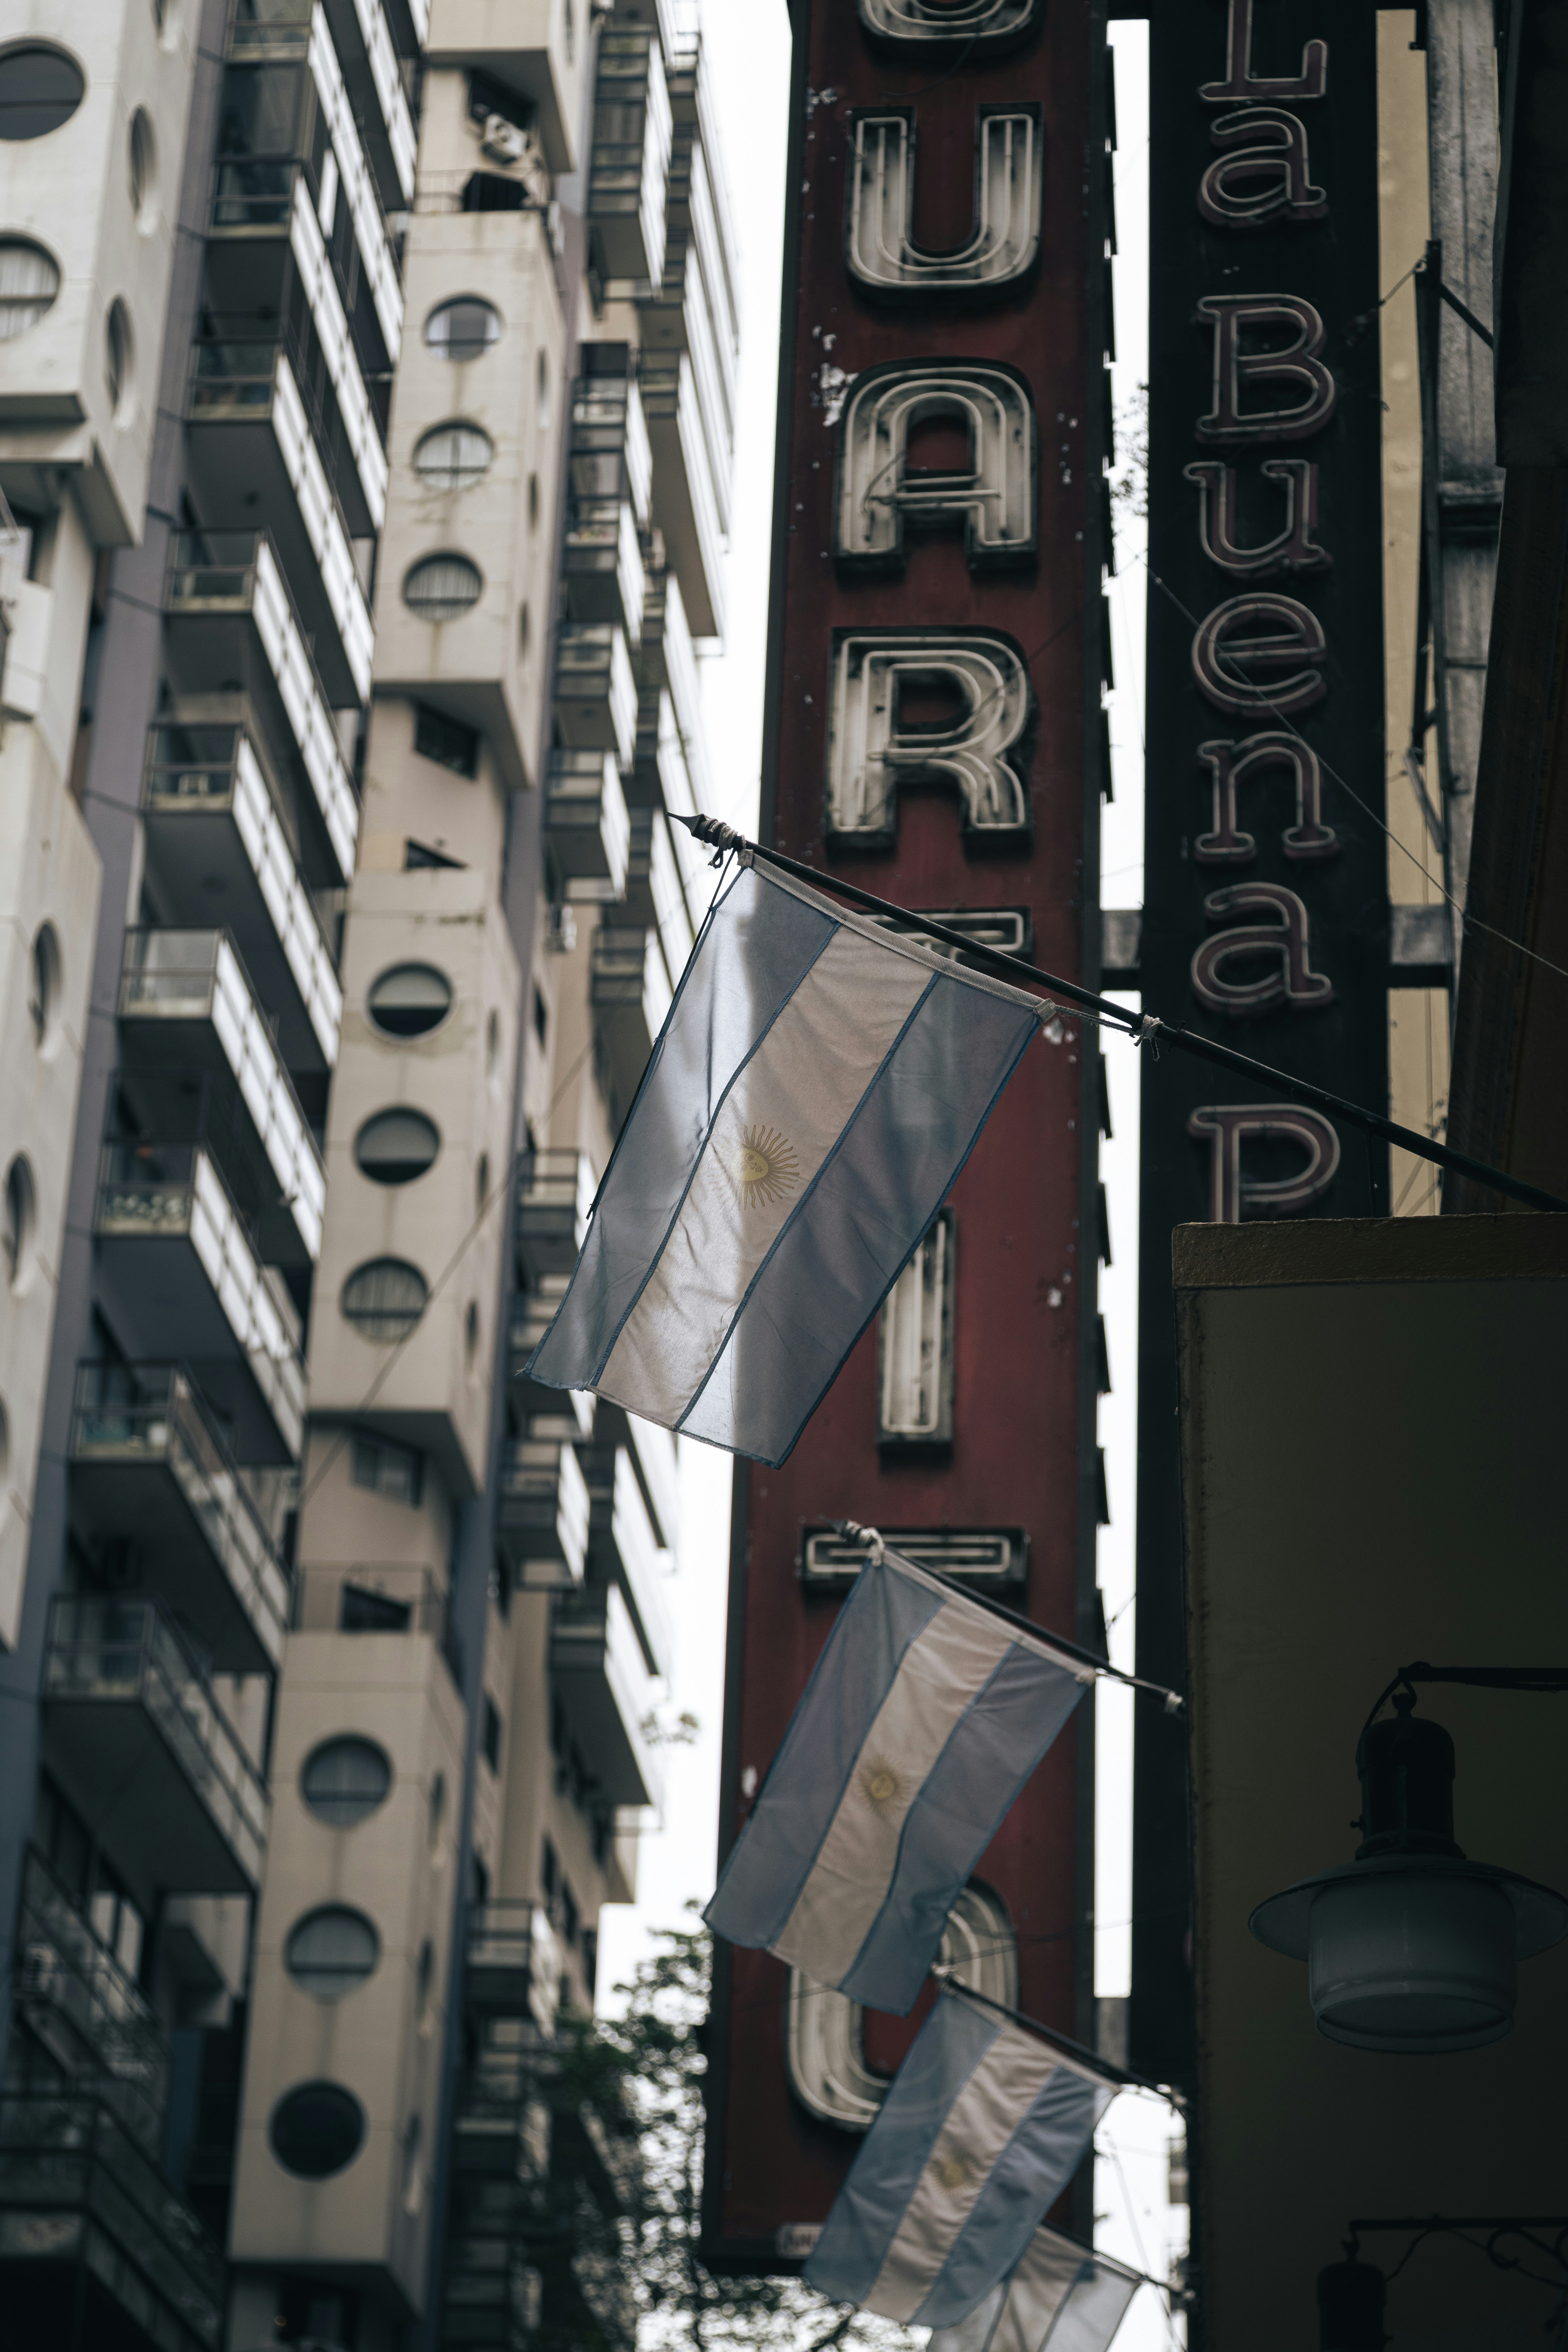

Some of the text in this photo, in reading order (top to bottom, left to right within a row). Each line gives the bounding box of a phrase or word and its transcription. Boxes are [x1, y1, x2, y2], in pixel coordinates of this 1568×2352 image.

[1196, 0, 1329, 229] La
[1182, 293, 1340, 1014] Buena
[785, 0, 1044, 2134] UARIO
